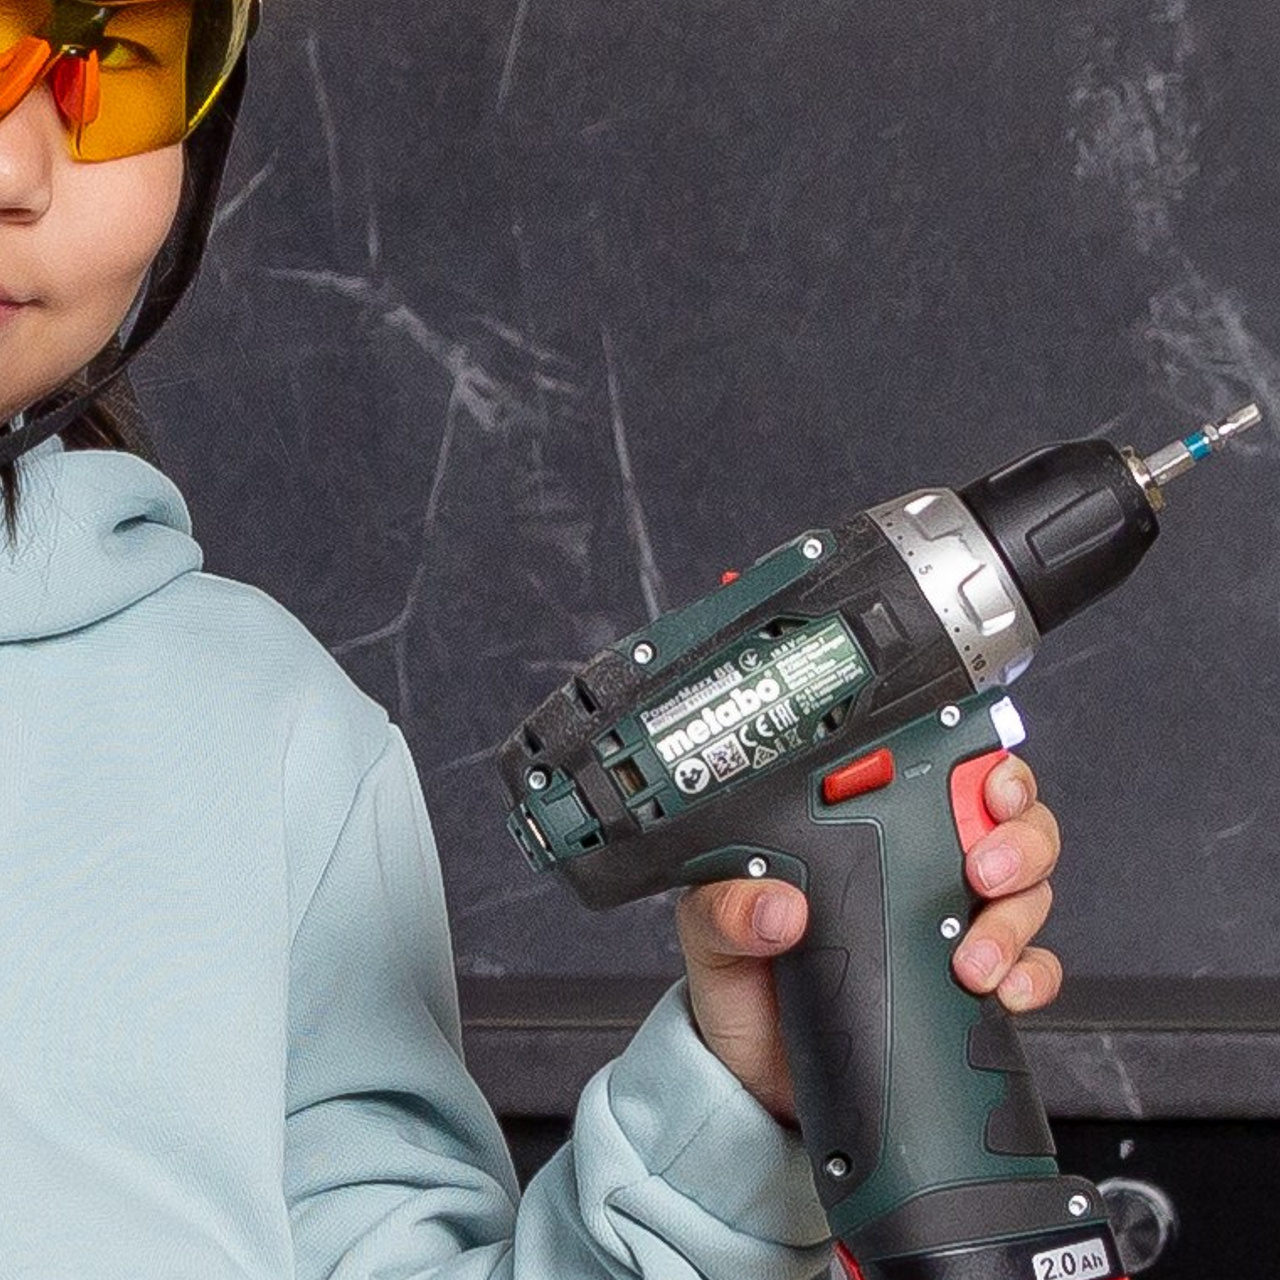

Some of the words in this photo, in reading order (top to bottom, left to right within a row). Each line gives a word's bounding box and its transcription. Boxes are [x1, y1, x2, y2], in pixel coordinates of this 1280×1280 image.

[918, 564, 933, 575] 5
[971, 653, 987, 671] 10
[656, 677, 780, 763] metabo
[1081, 1253, 1104, 1272] Ah
